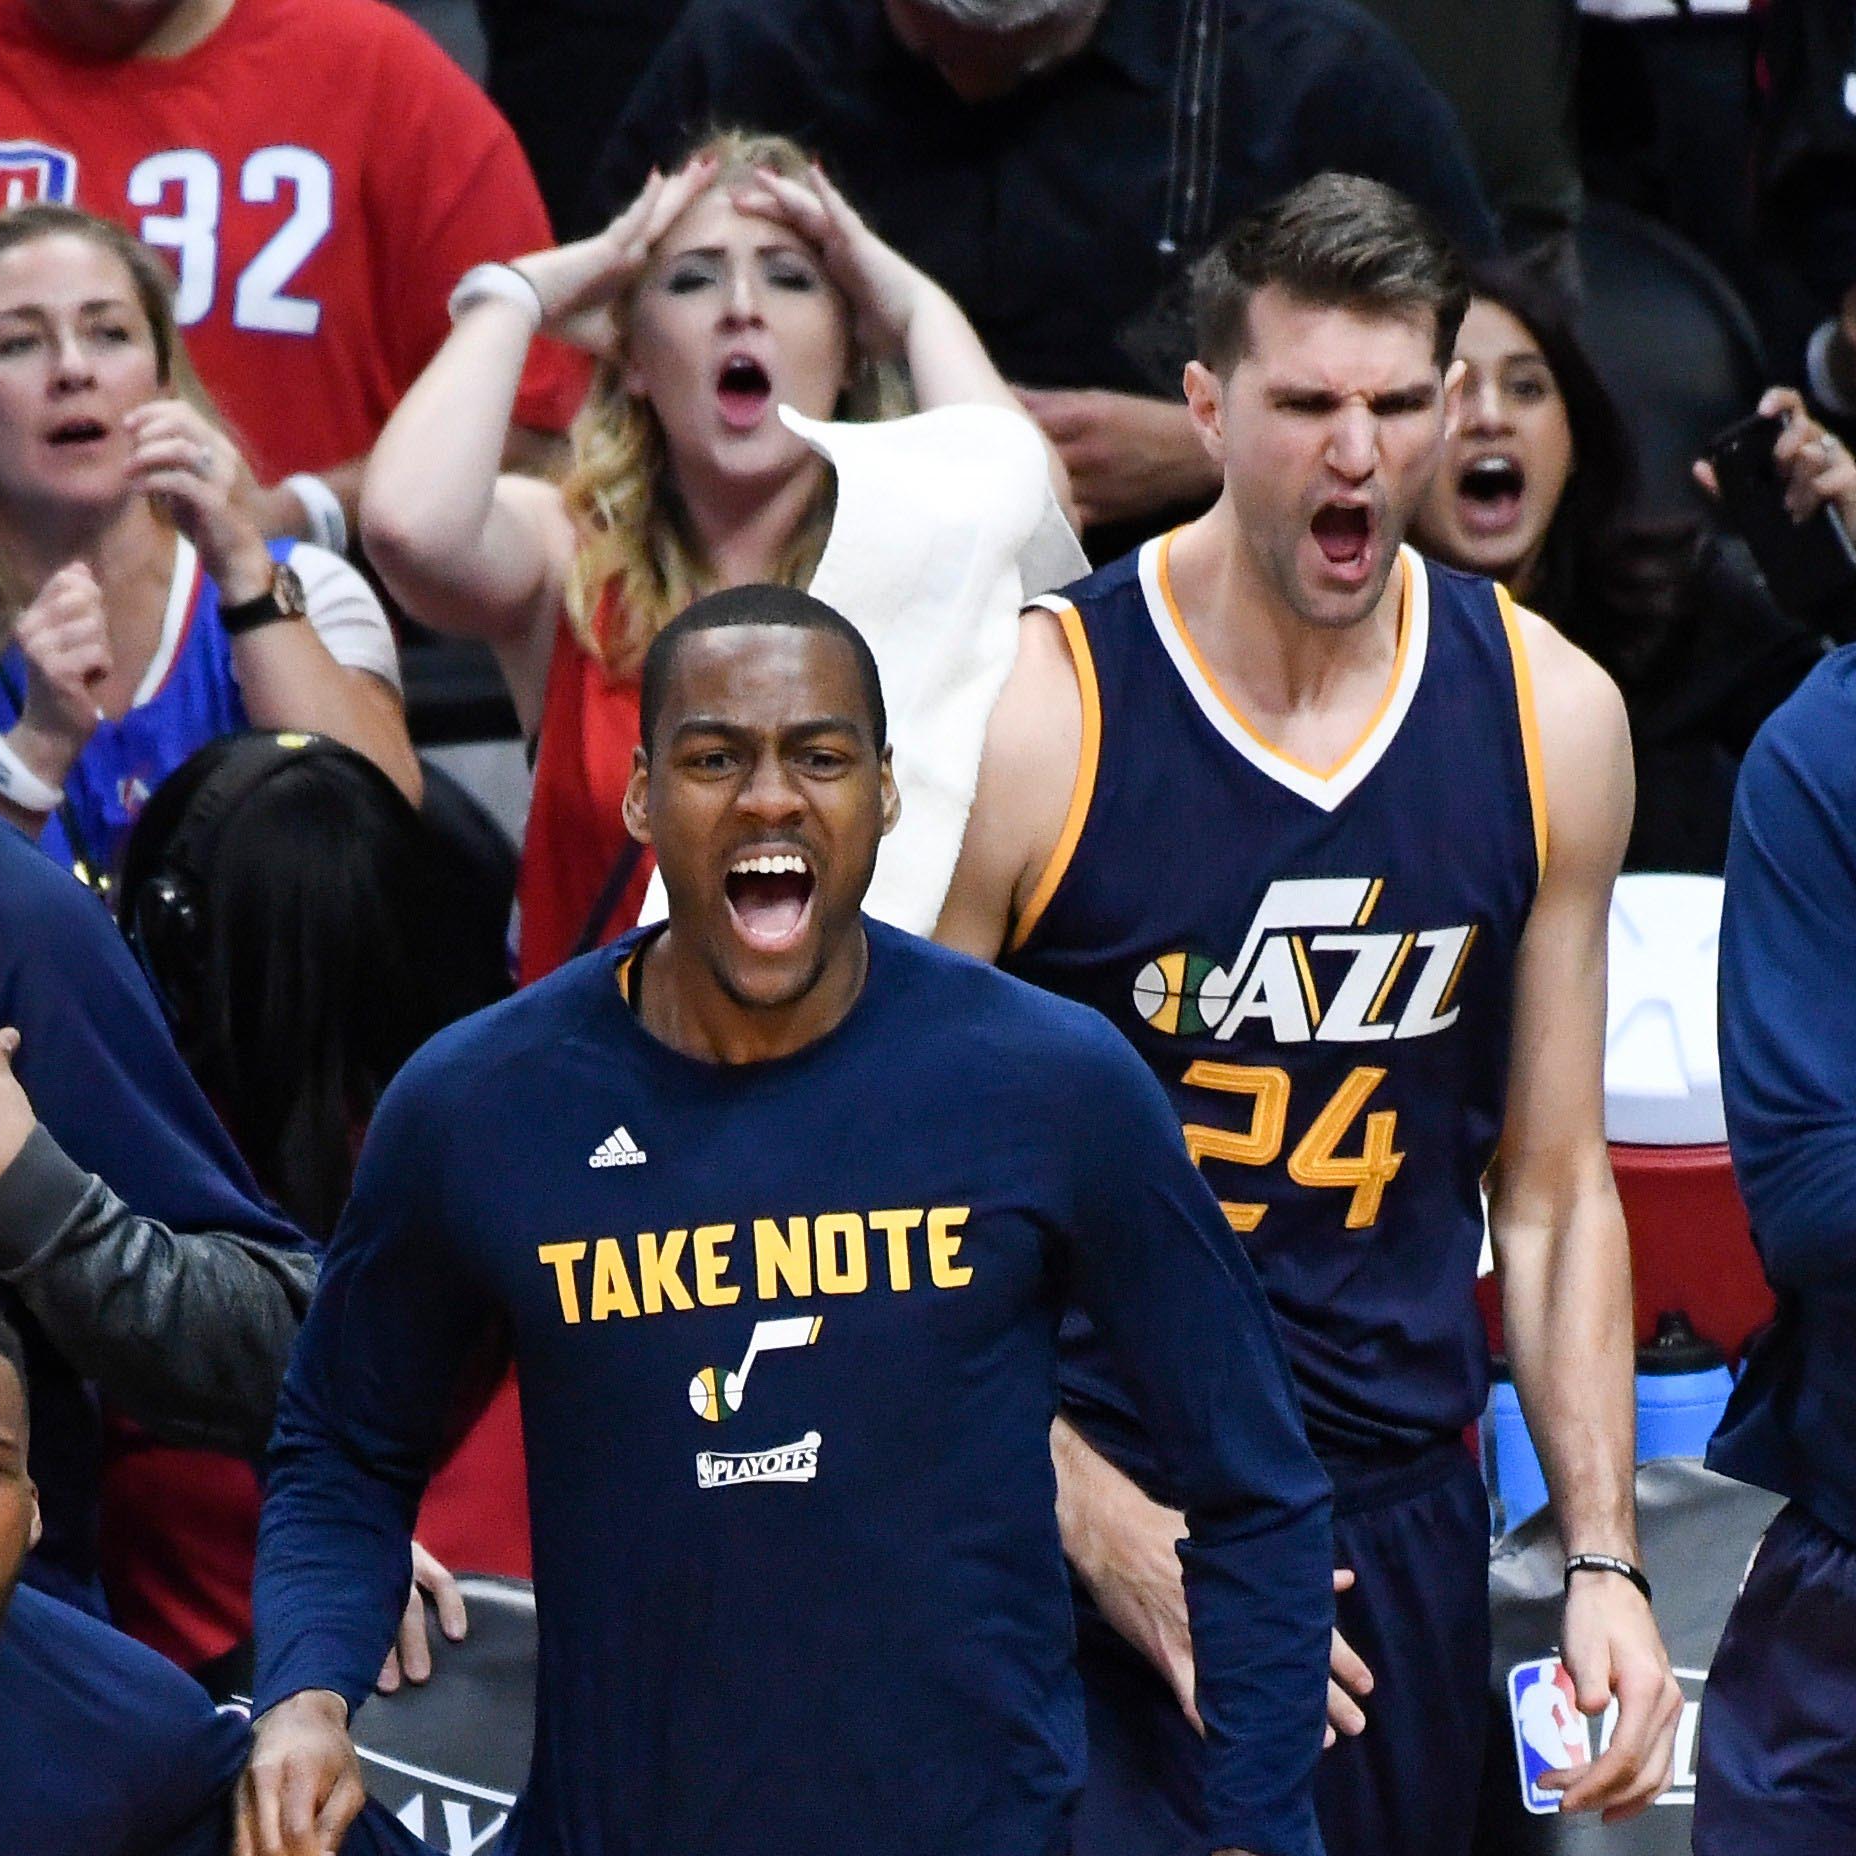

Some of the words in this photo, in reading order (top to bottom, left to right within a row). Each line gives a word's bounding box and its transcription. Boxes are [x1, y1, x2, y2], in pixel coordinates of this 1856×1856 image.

[126, 142, 334, 336] 32
[1132, 877, 1478, 1043] JAZZ
[589, 1149, 647, 1168] adidas
[1180, 1059, 1406, 1232] 24
[538, 1224, 742, 1324] TAKE
[753, 1206, 974, 1299] NOTE
[712, 1448, 819, 1482] PLAYOFFS
